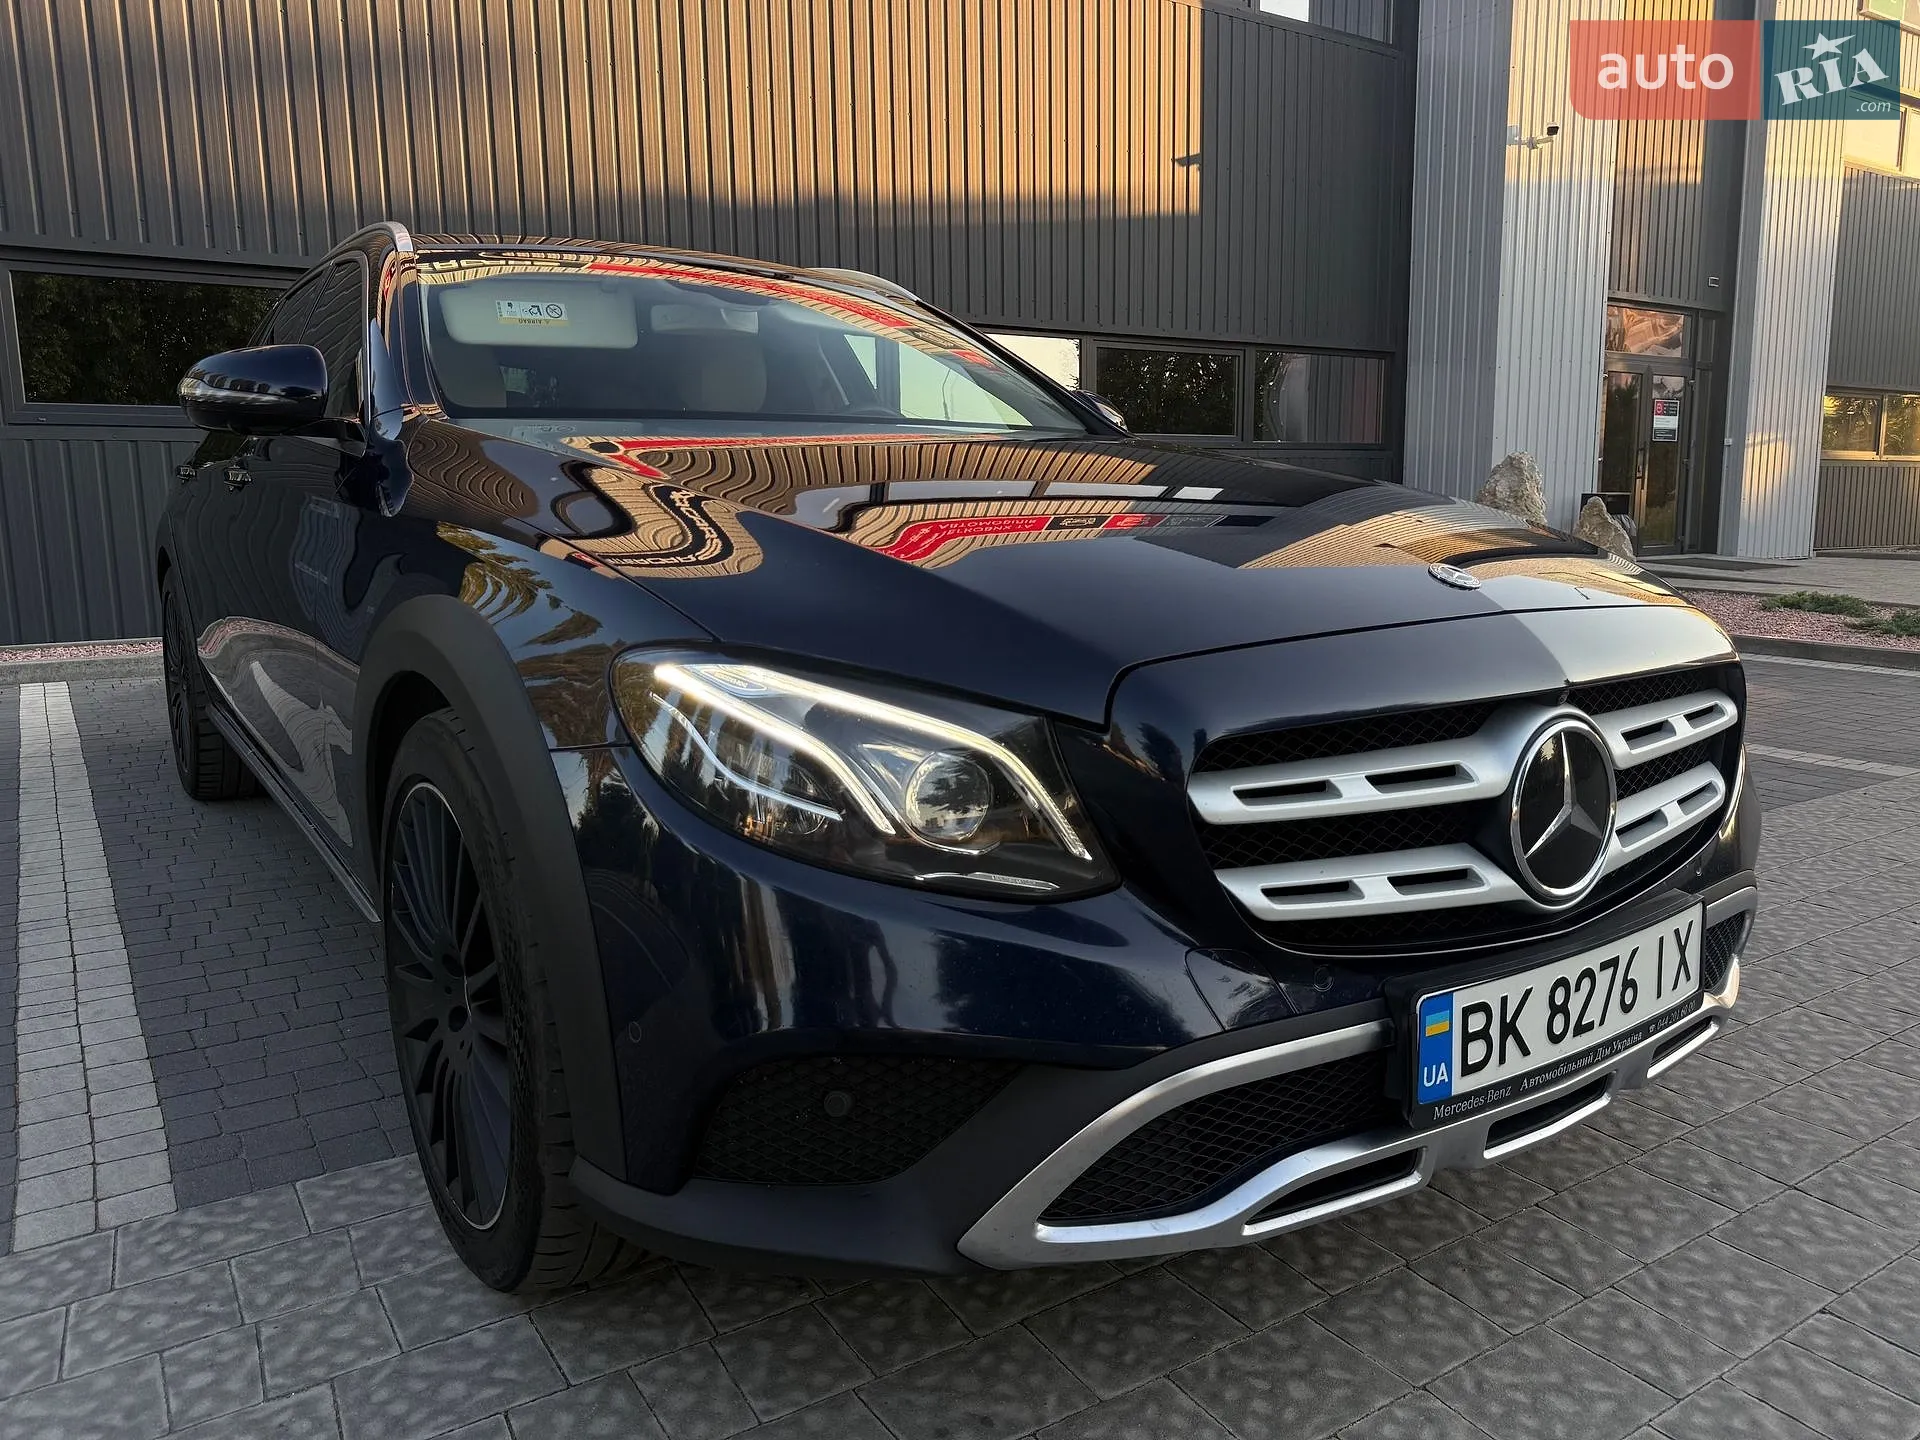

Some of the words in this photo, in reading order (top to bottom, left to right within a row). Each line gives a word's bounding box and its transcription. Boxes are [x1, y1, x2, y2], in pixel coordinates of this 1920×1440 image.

[1461, 986, 1533, 1077] BK
[1547, 946, 1640, 1045] 8276
[1656, 920, 1693, 999] IX
[1423, 1062, 1449, 1087] UA
[1433, 1085, 1512, 1120] Mercedes-Benz
[1519, 1051, 1594, 1091] Автомобільний
[1594, 1045, 1612, 1063] Дім
[1612, 1032, 1643, 1053] Україна
